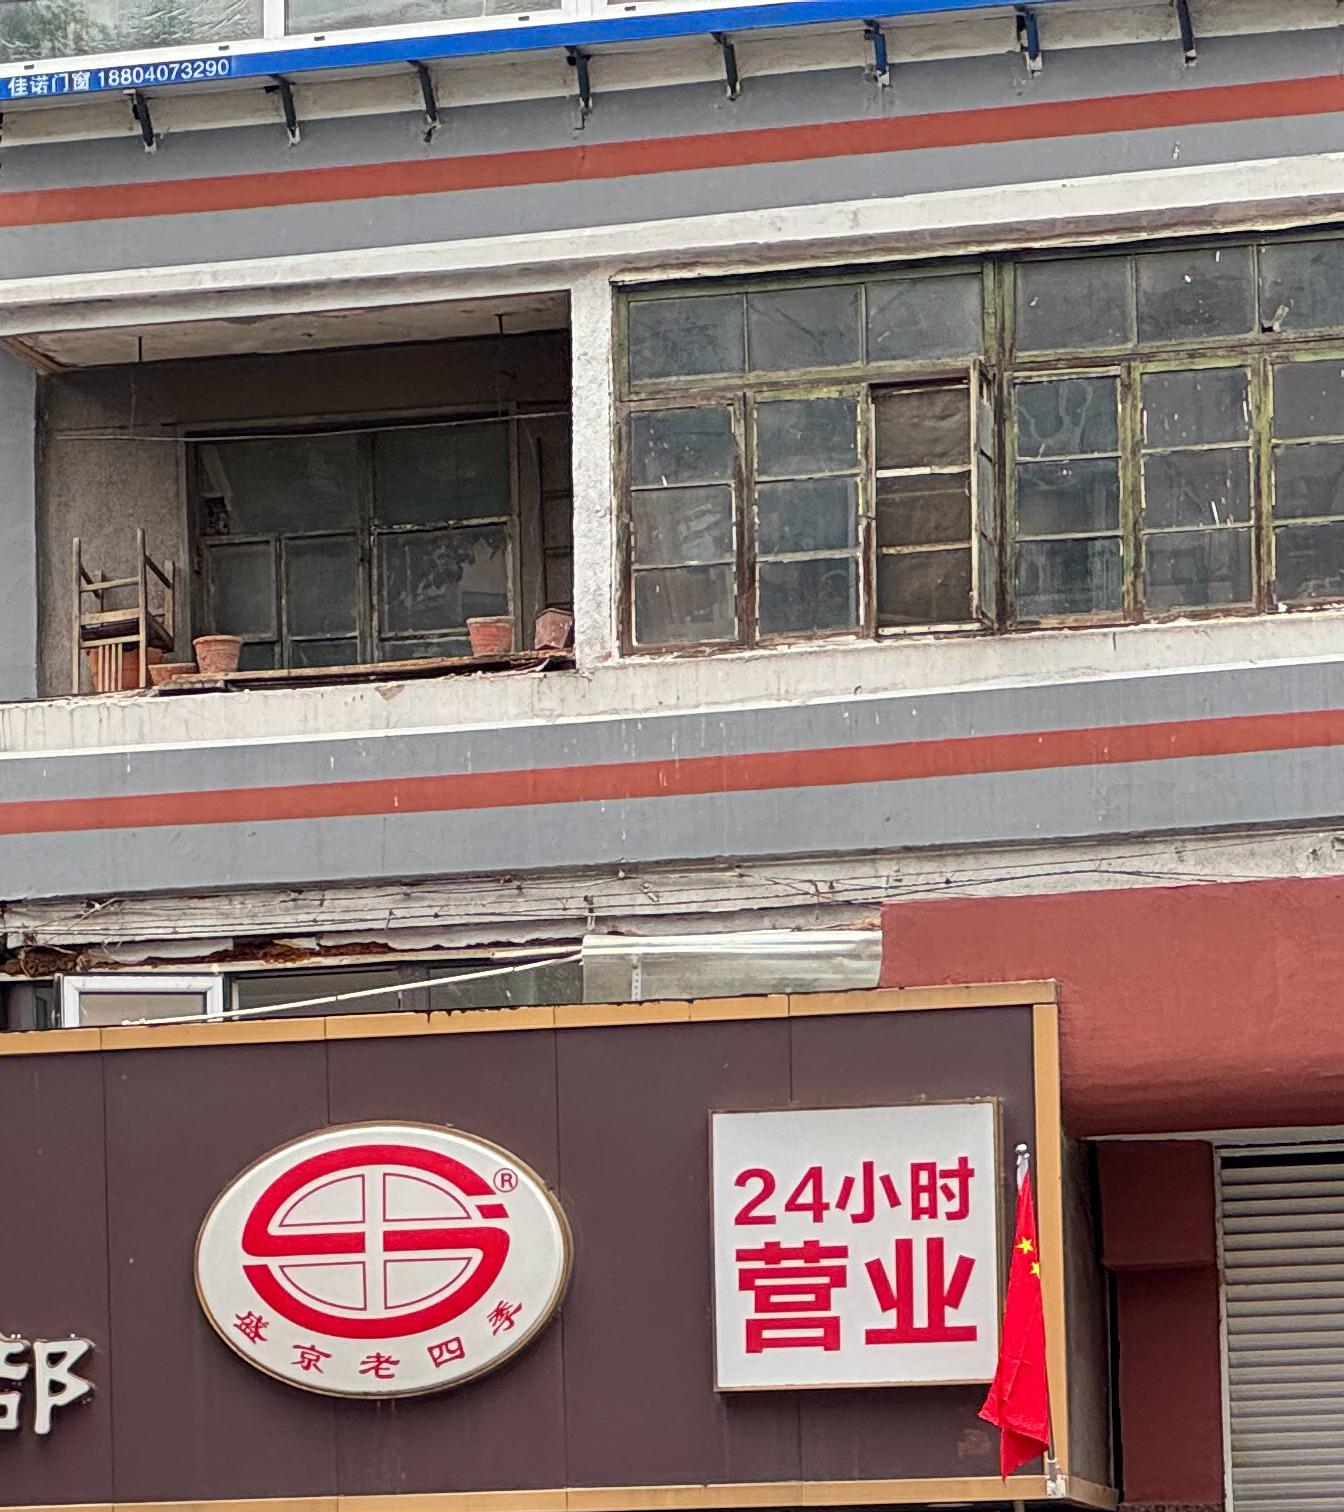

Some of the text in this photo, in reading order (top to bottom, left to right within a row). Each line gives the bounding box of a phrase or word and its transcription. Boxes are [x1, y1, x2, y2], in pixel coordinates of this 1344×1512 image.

[8, 58, 230, 97] 佳诺门窗 18804073290
[733, 1156, 975, 1226] 24小时
[735, 1236, 978, 1354] 营业
[232, 1299, 523, 1380] 盛京老四季
